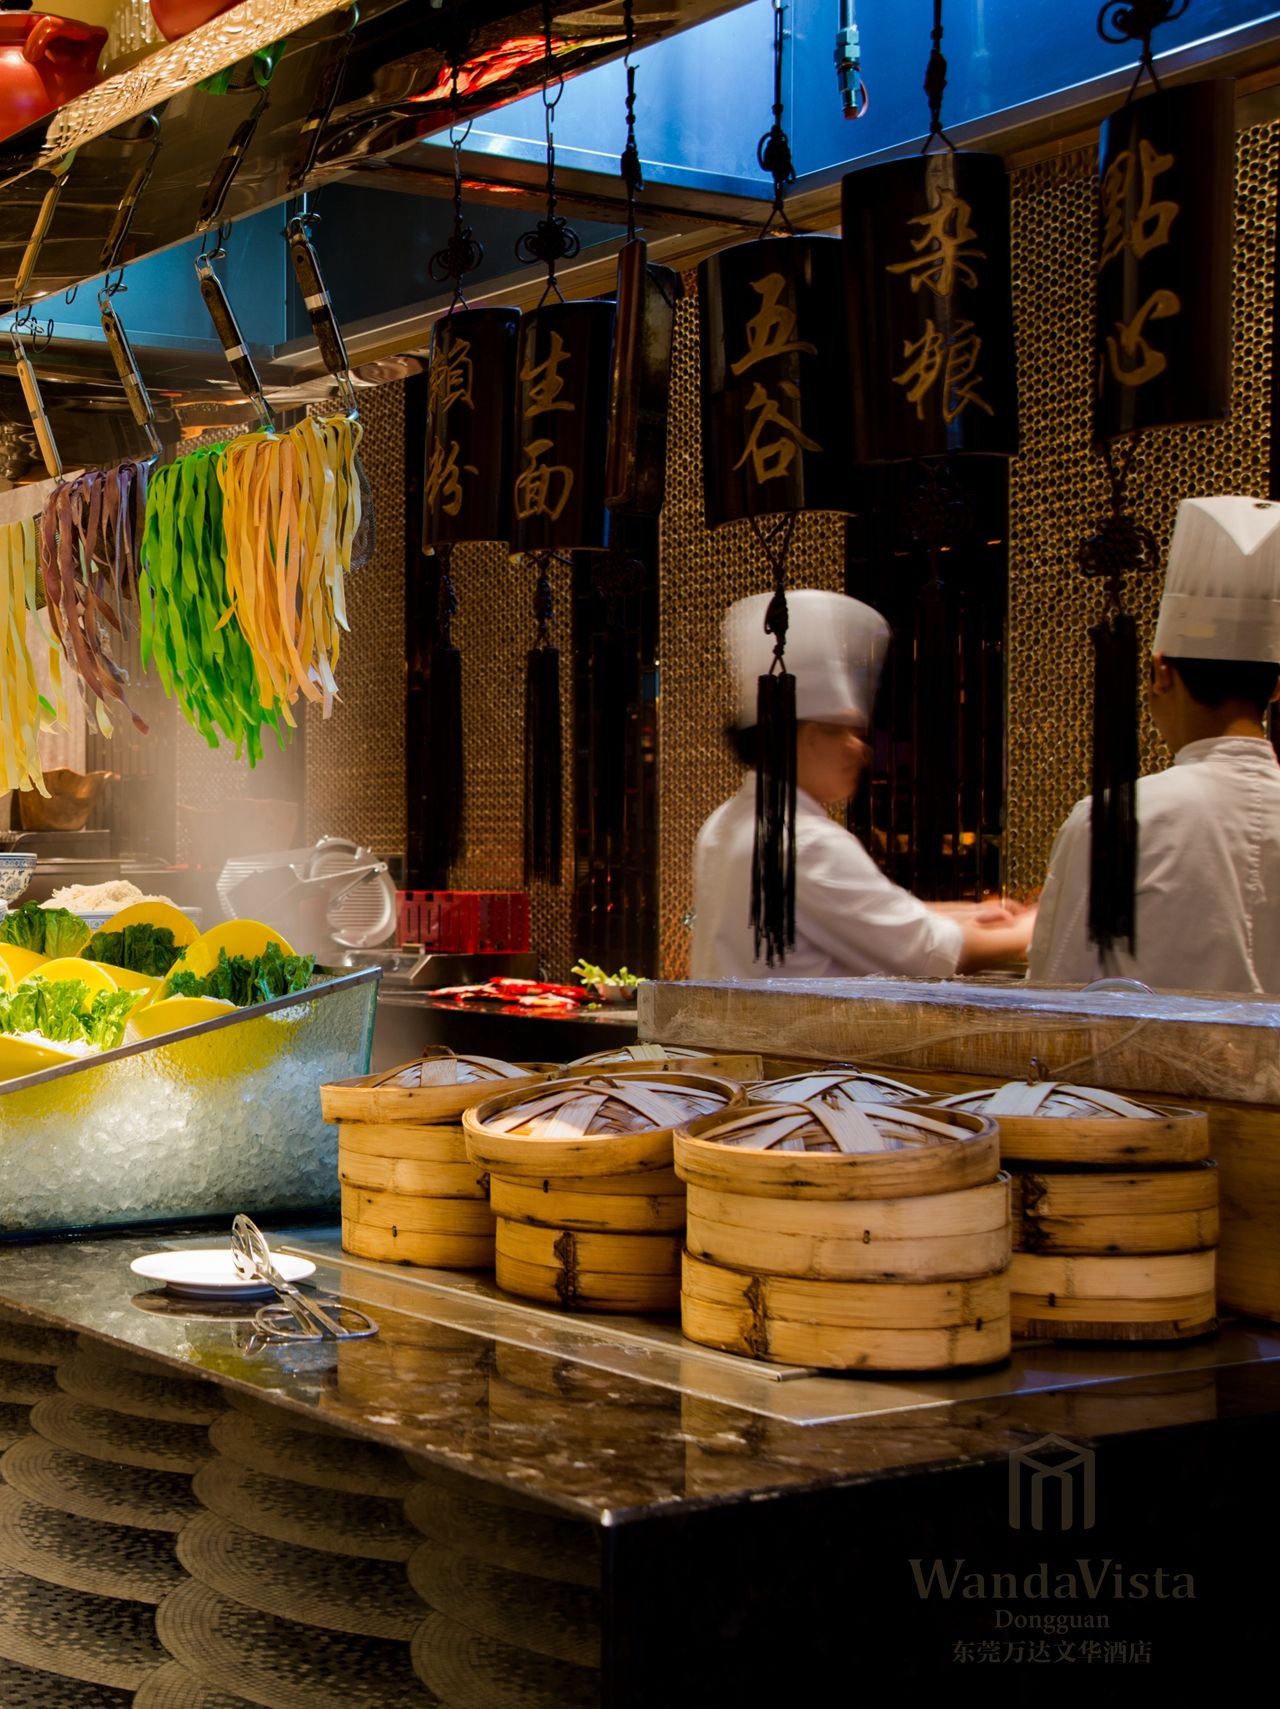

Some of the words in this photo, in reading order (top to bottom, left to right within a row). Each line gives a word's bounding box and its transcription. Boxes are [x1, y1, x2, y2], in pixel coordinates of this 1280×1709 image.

[884, 186, 998, 424] 杂粮
[1098, 138, 1184, 387] 點心
[513, 330, 578, 522] 生面
[730, 271, 825, 485] 五谷
